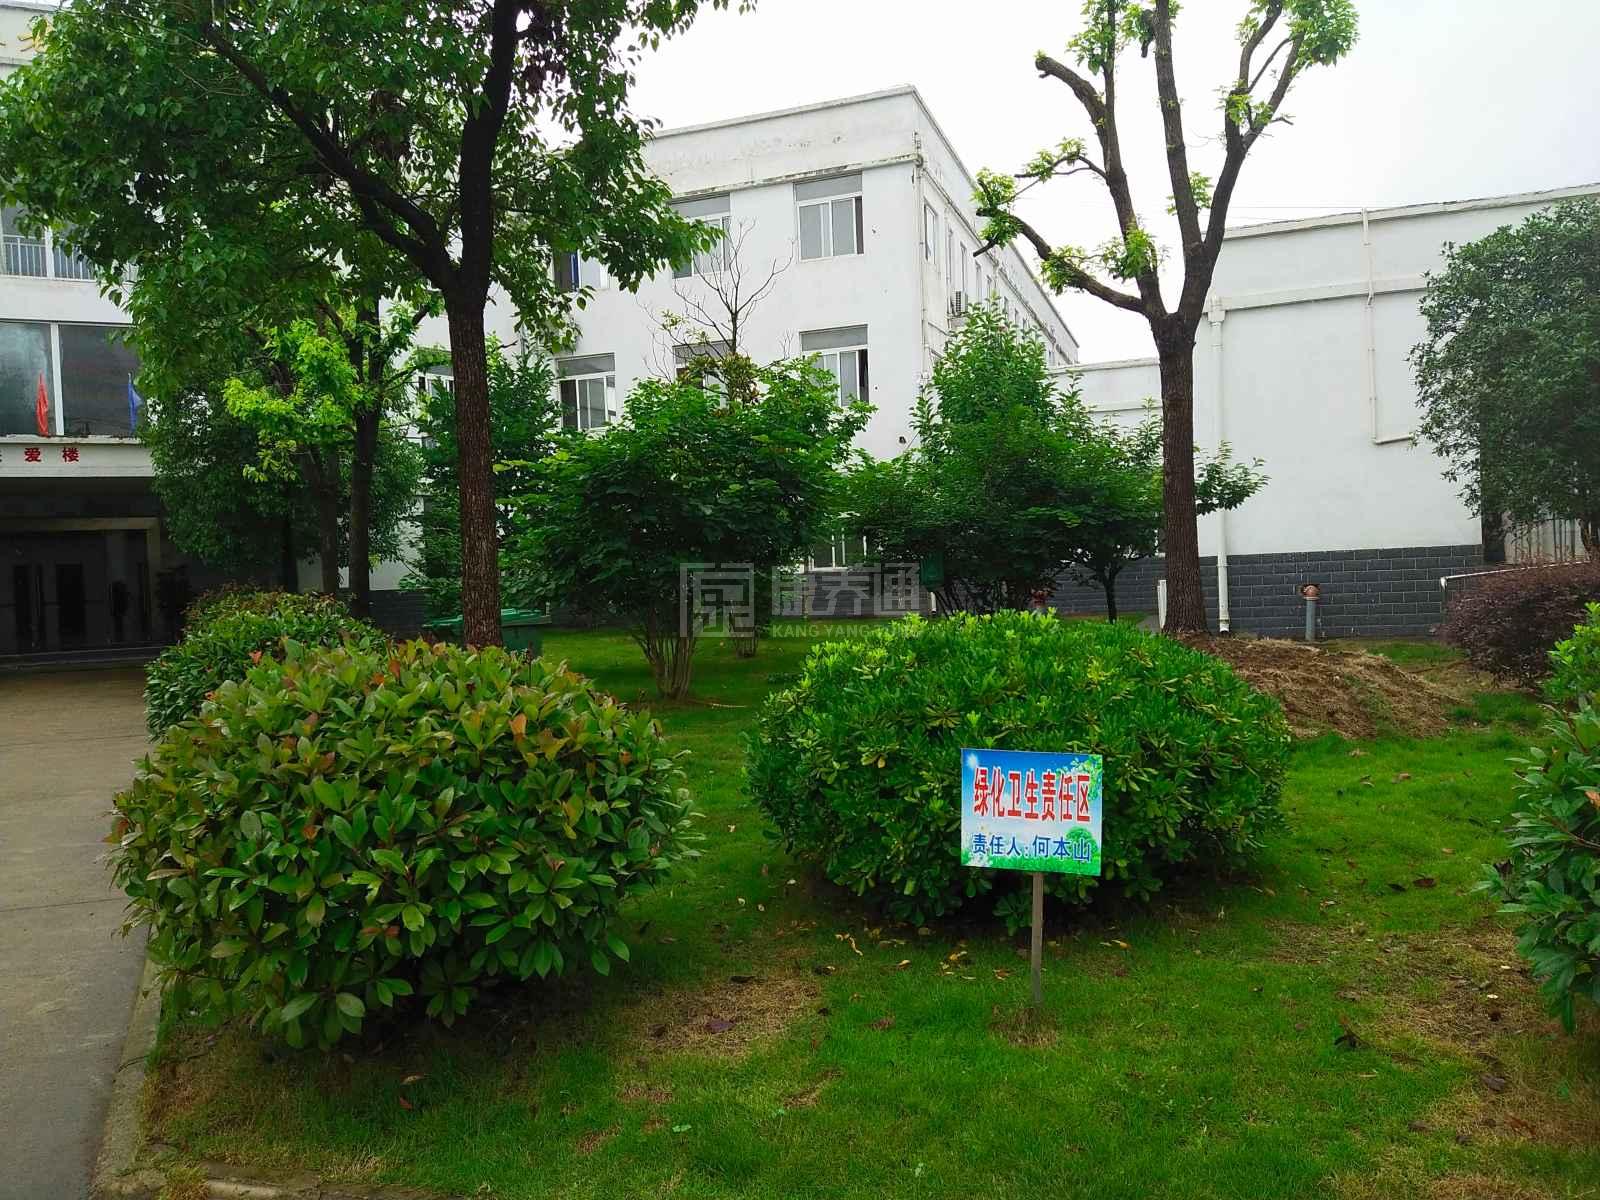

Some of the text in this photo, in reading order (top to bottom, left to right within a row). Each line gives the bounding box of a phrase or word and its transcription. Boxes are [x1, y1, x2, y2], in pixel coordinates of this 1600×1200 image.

[0, 447, 80, 463] 爱楼
[973, 766, 1091, 823] 绿化卫生责任区
